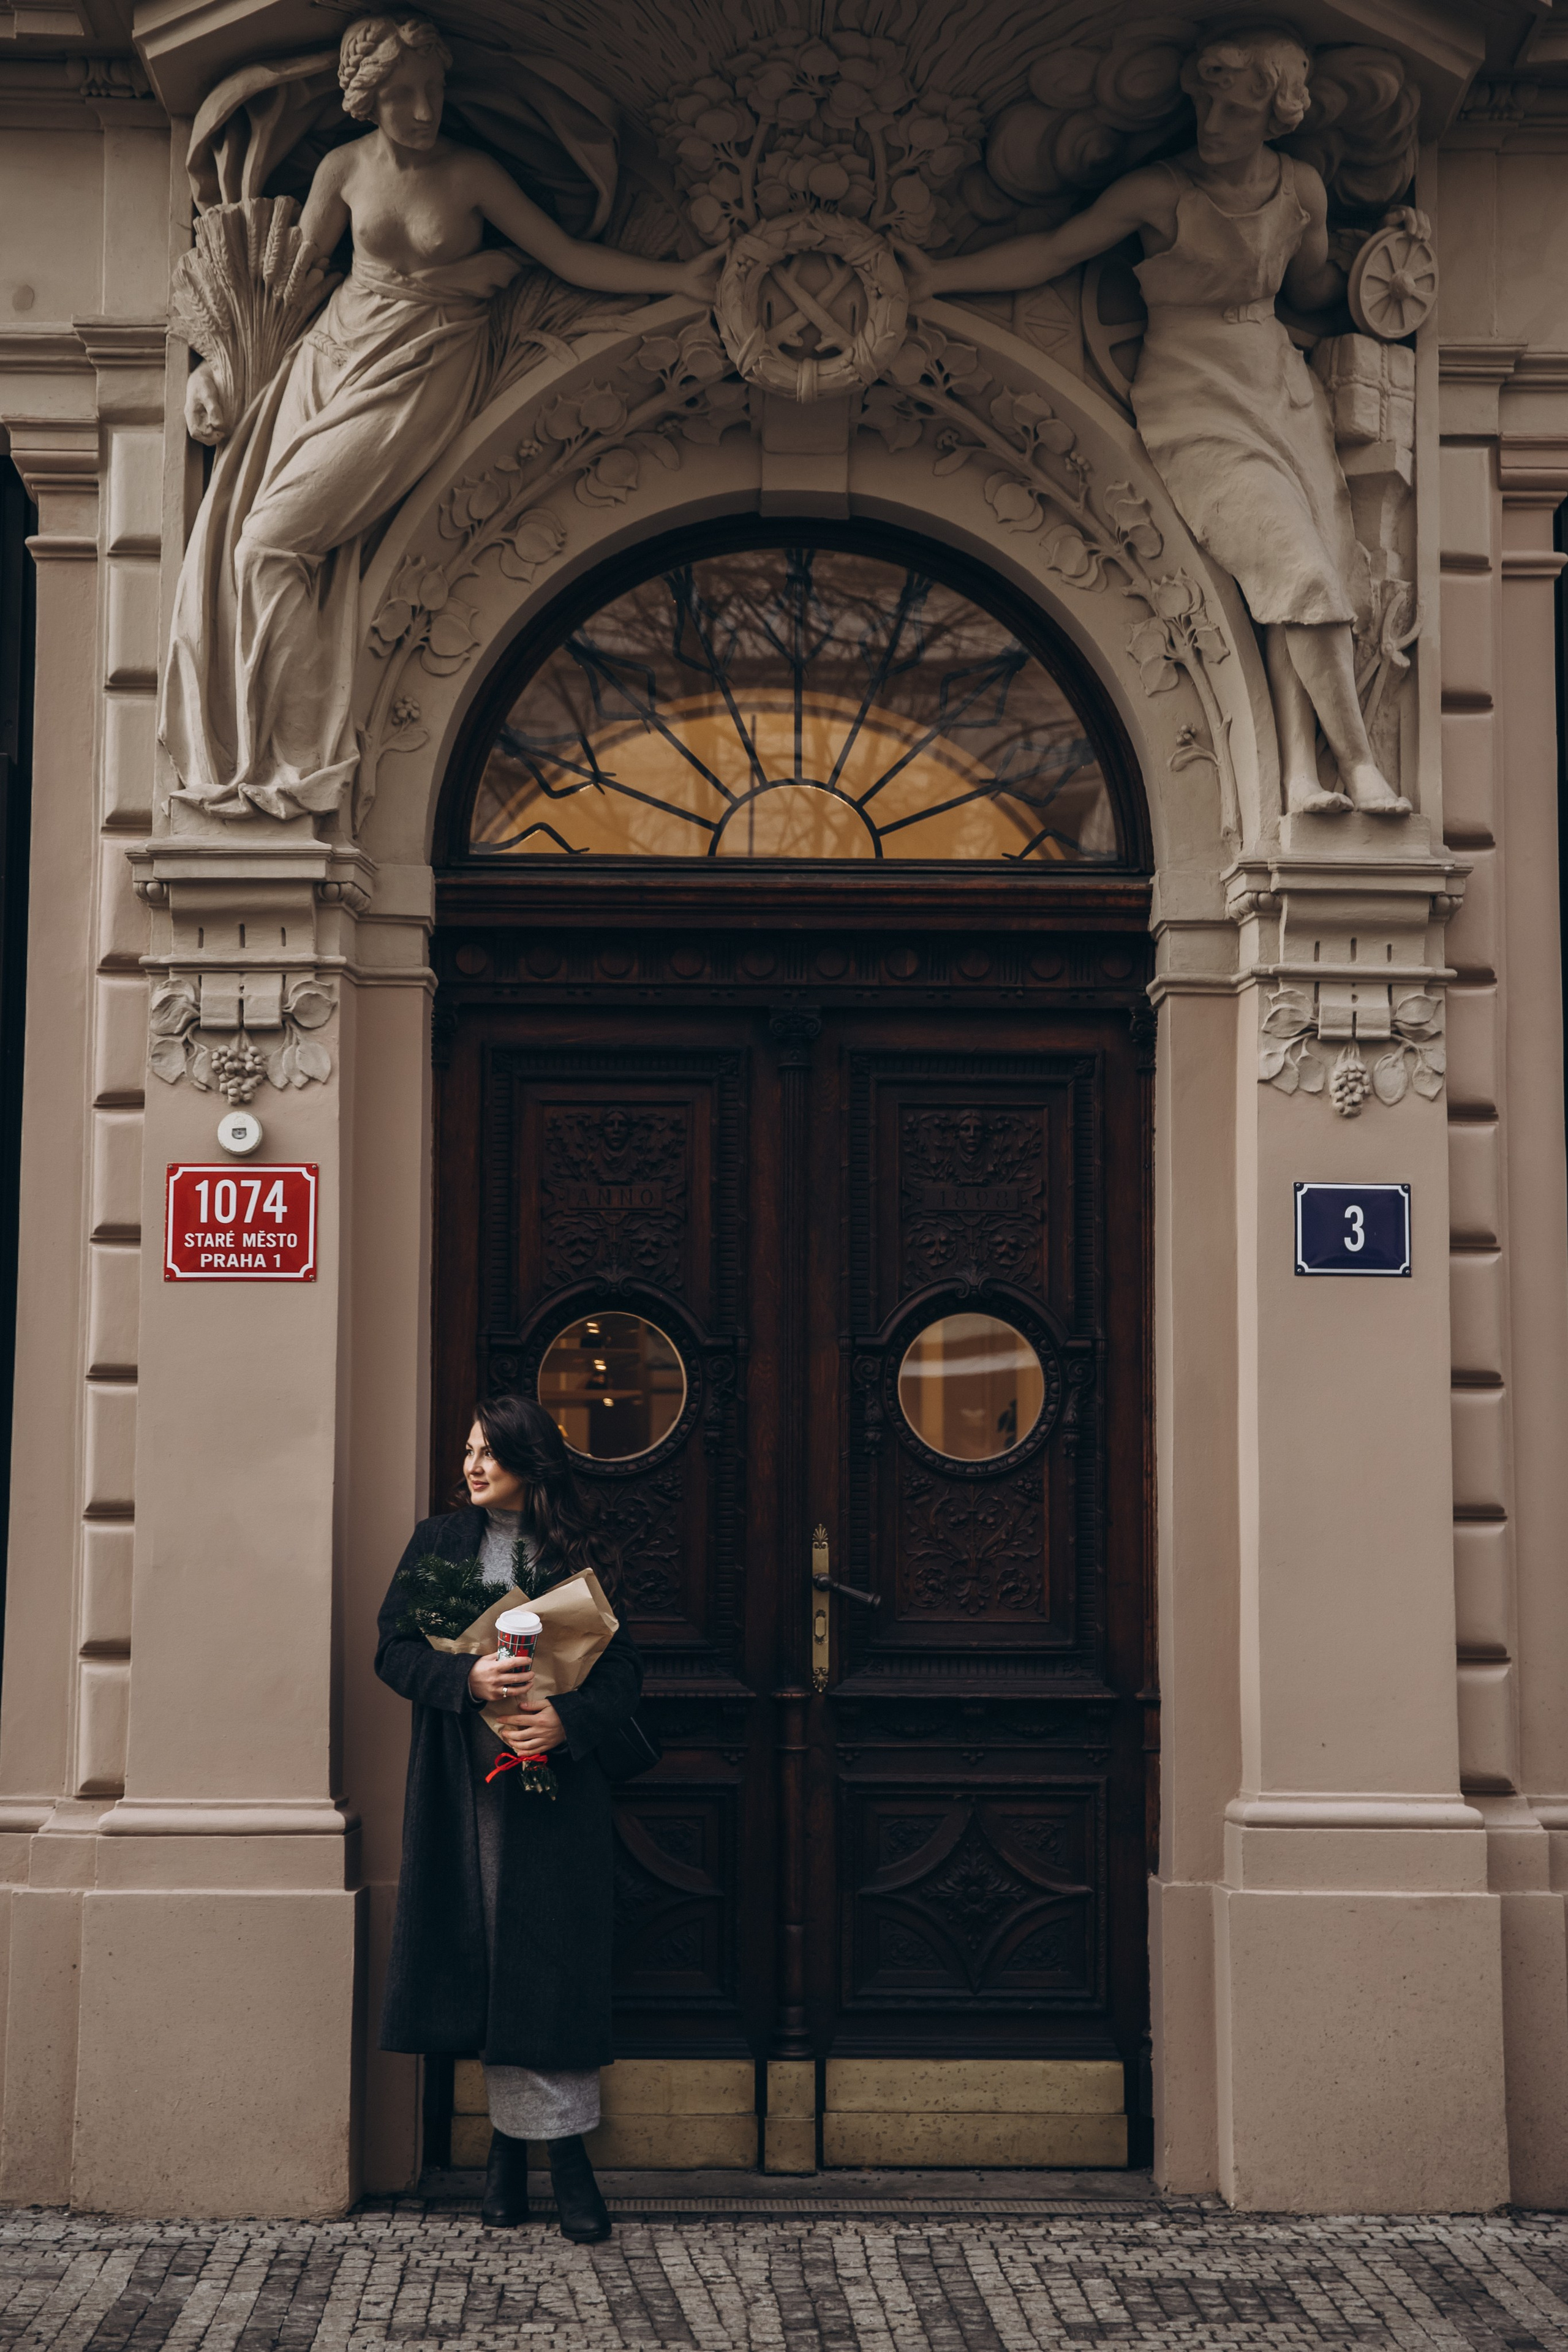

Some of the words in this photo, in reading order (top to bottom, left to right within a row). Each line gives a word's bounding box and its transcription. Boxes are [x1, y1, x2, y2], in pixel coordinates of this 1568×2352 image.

[195, 1179, 287, 1224] 1074
[577, 1189, 654, 1206] ANNO
[939, 1190, 1009, 1208] 1898
[1344, 1205, 1365, 1252] 3
[184, 1230, 235, 1248] STARÉ
[243, 1230, 298, 1248] MĚSTO
[200, 1253, 266, 1268] PRAHA
[273, 1254, 281, 1267] 1
